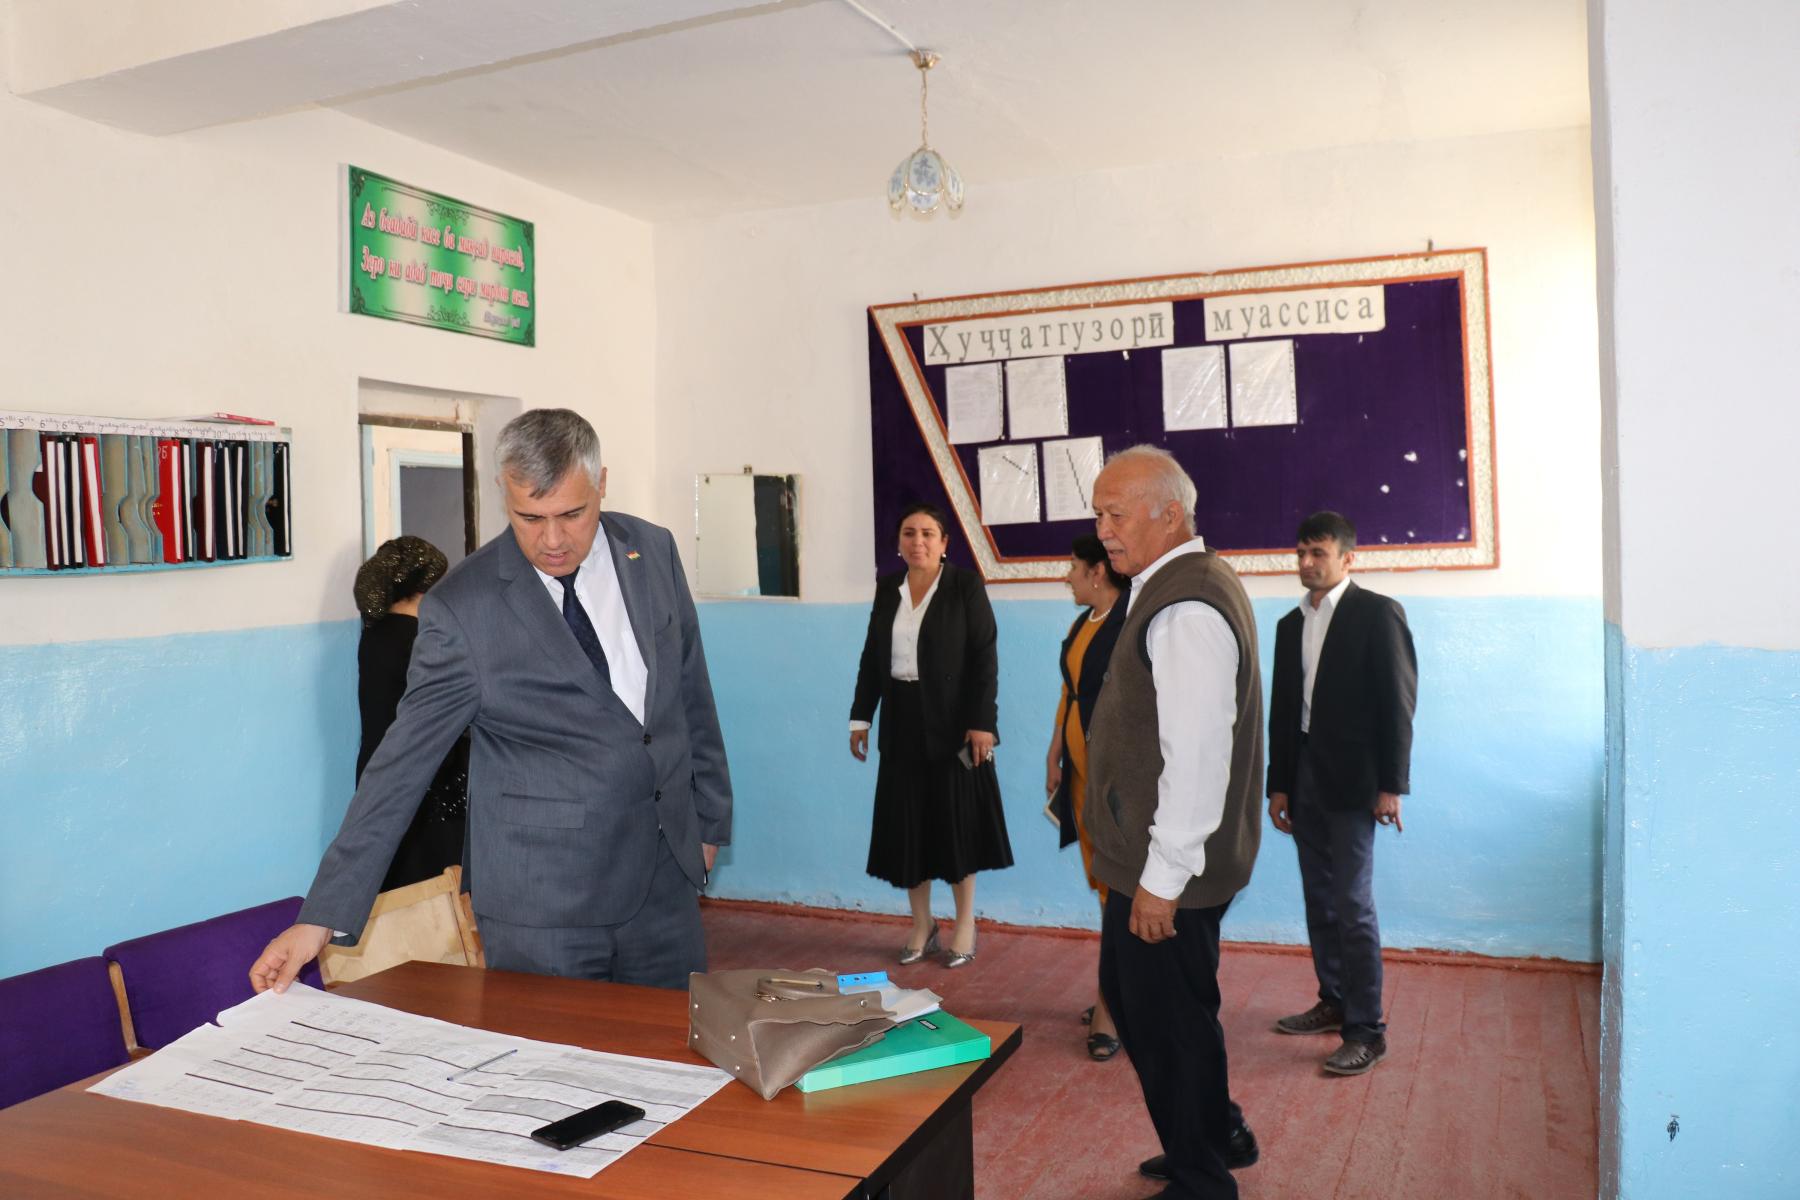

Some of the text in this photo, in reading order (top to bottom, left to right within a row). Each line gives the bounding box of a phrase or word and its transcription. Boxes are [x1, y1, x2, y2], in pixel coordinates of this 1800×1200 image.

[361, 202, 376, 229] Аз
[443, 225, 456, 250] ба
[361, 246, 385, 280] Зеро
[388, 259, 402, 278] ки
[1213, 296, 1374, 338] муассиса
